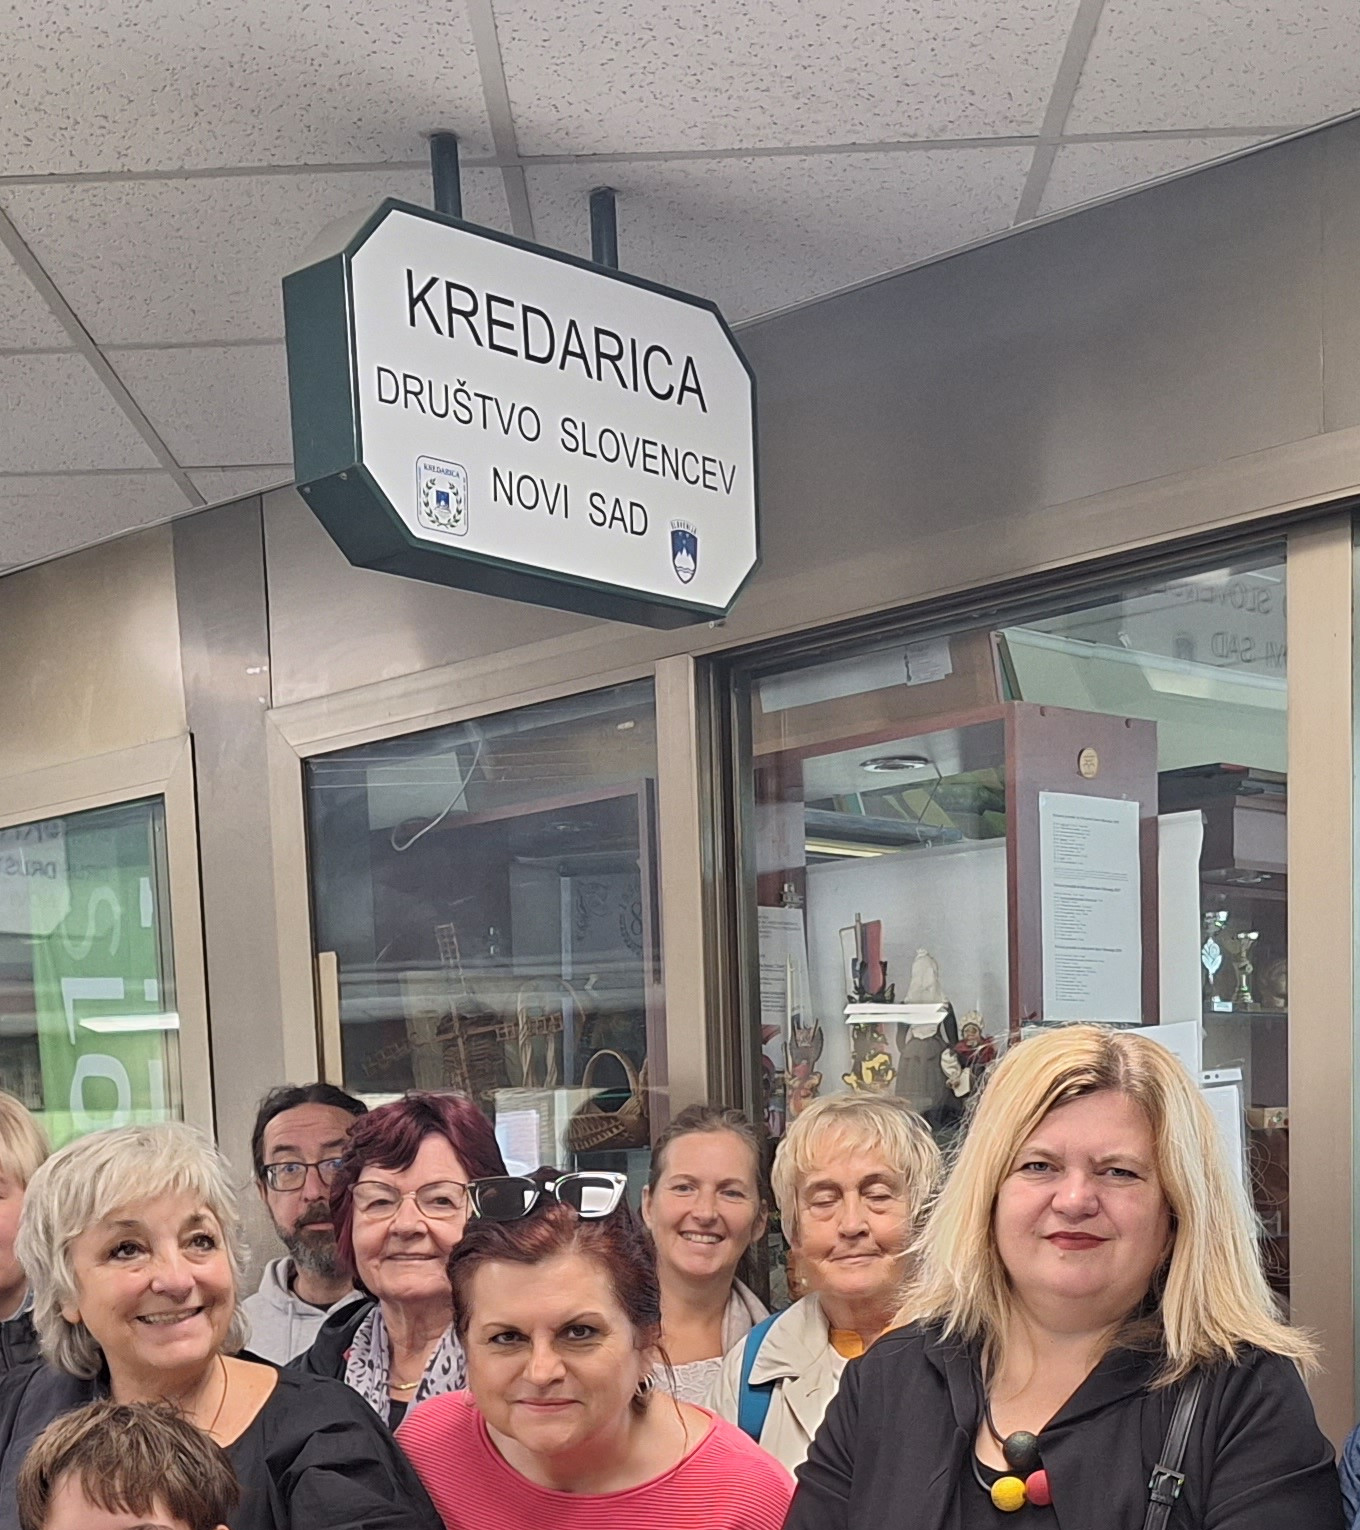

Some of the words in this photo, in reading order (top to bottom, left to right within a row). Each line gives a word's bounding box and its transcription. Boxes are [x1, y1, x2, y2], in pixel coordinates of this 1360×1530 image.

[406, 268, 708, 413] KREDARICA
[376, 366, 541, 442] DRUŠTVO
[561, 416, 737, 495] SLOVENCEV
[492, 467, 569, 519] NOVI
[588, 493, 649, 536] SAD
